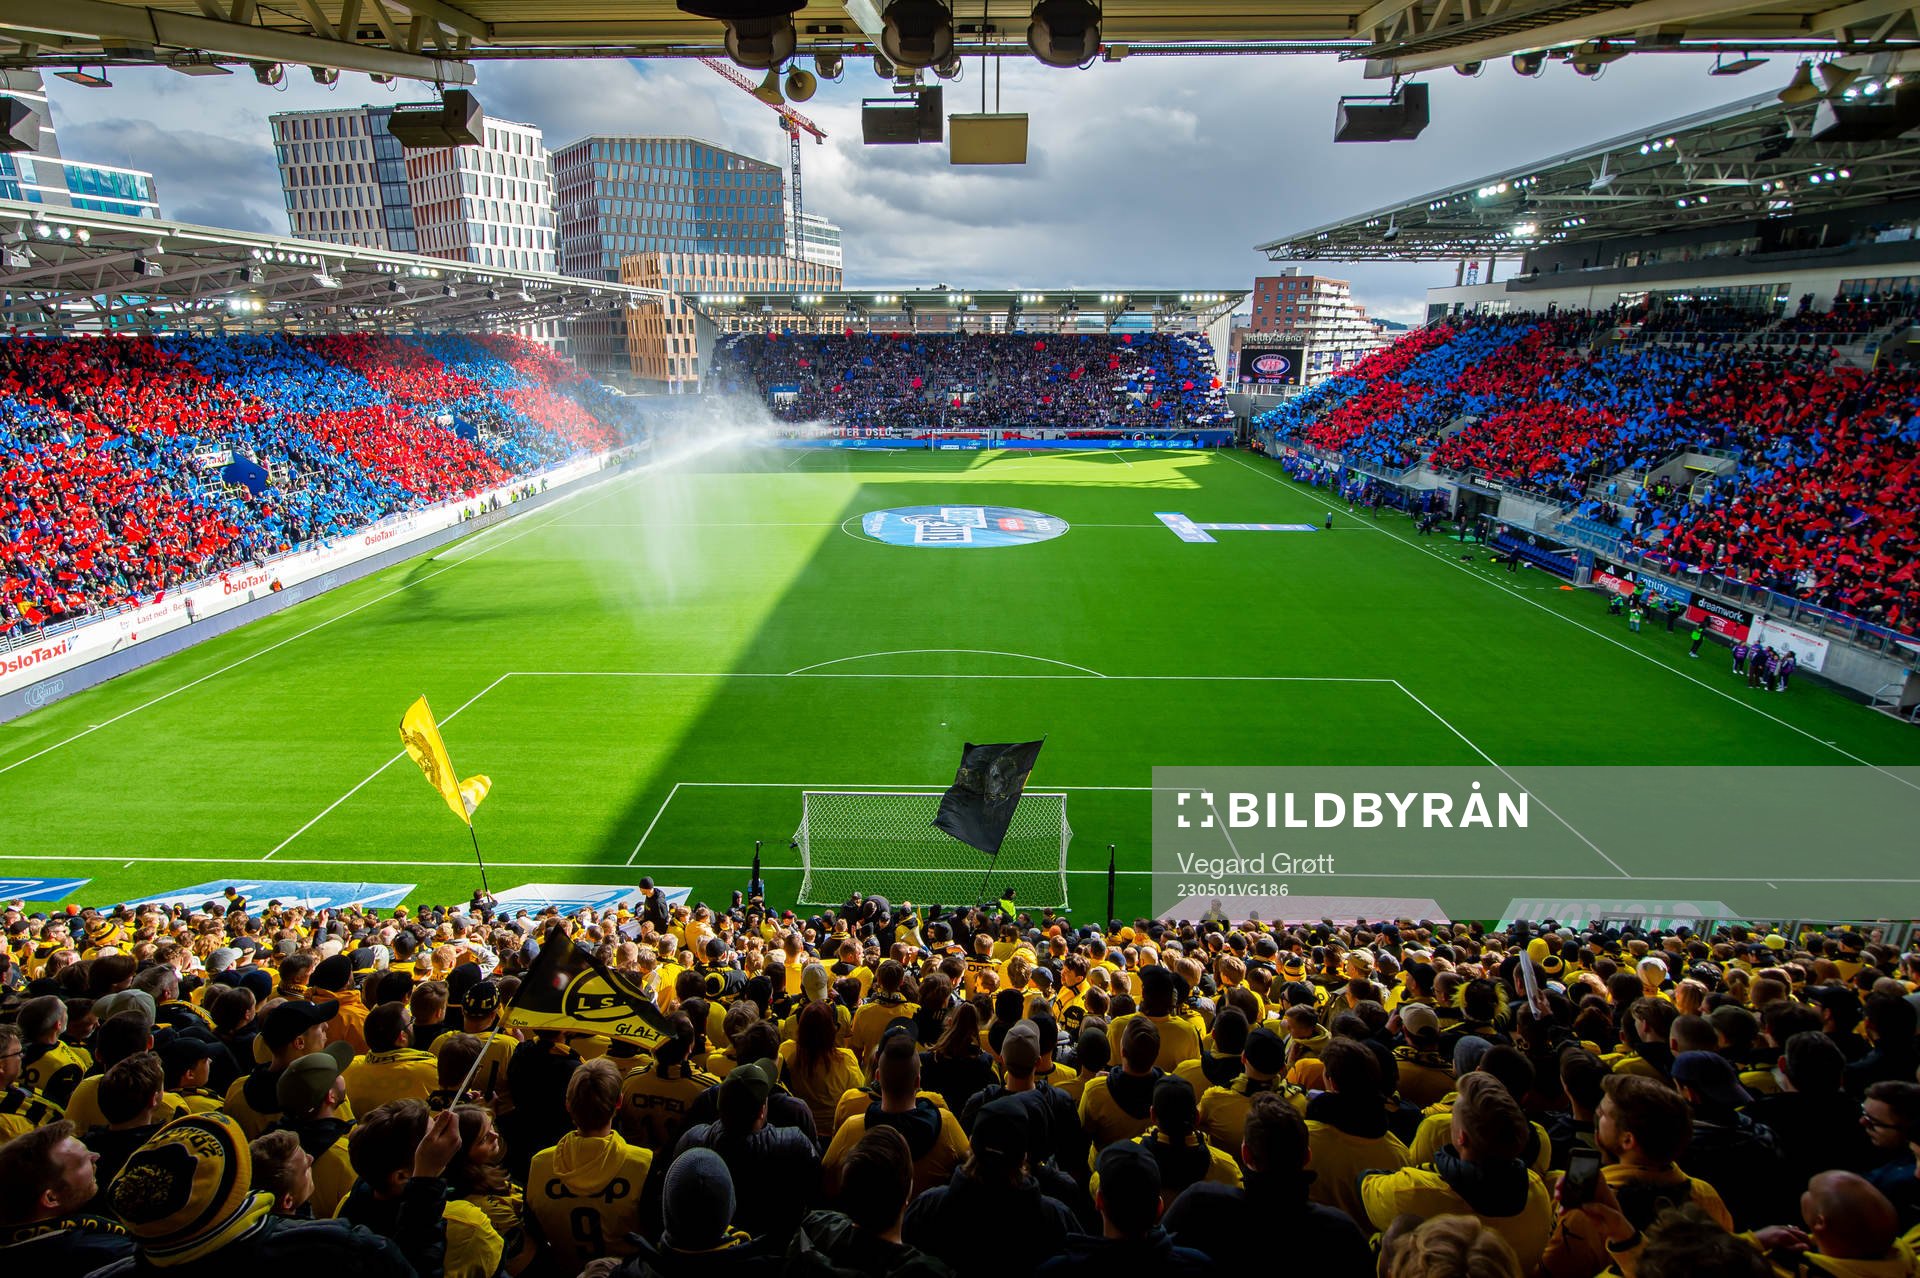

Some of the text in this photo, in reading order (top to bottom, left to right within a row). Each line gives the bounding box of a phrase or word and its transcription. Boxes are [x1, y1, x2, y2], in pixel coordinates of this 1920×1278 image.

[223, 571, 268, 595] OsloTaxi
[1698, 598, 1744, 622] dreamwork.
[0, 640, 67, 676] OsloTaxi
[570, 1206, 605, 1256] 9
